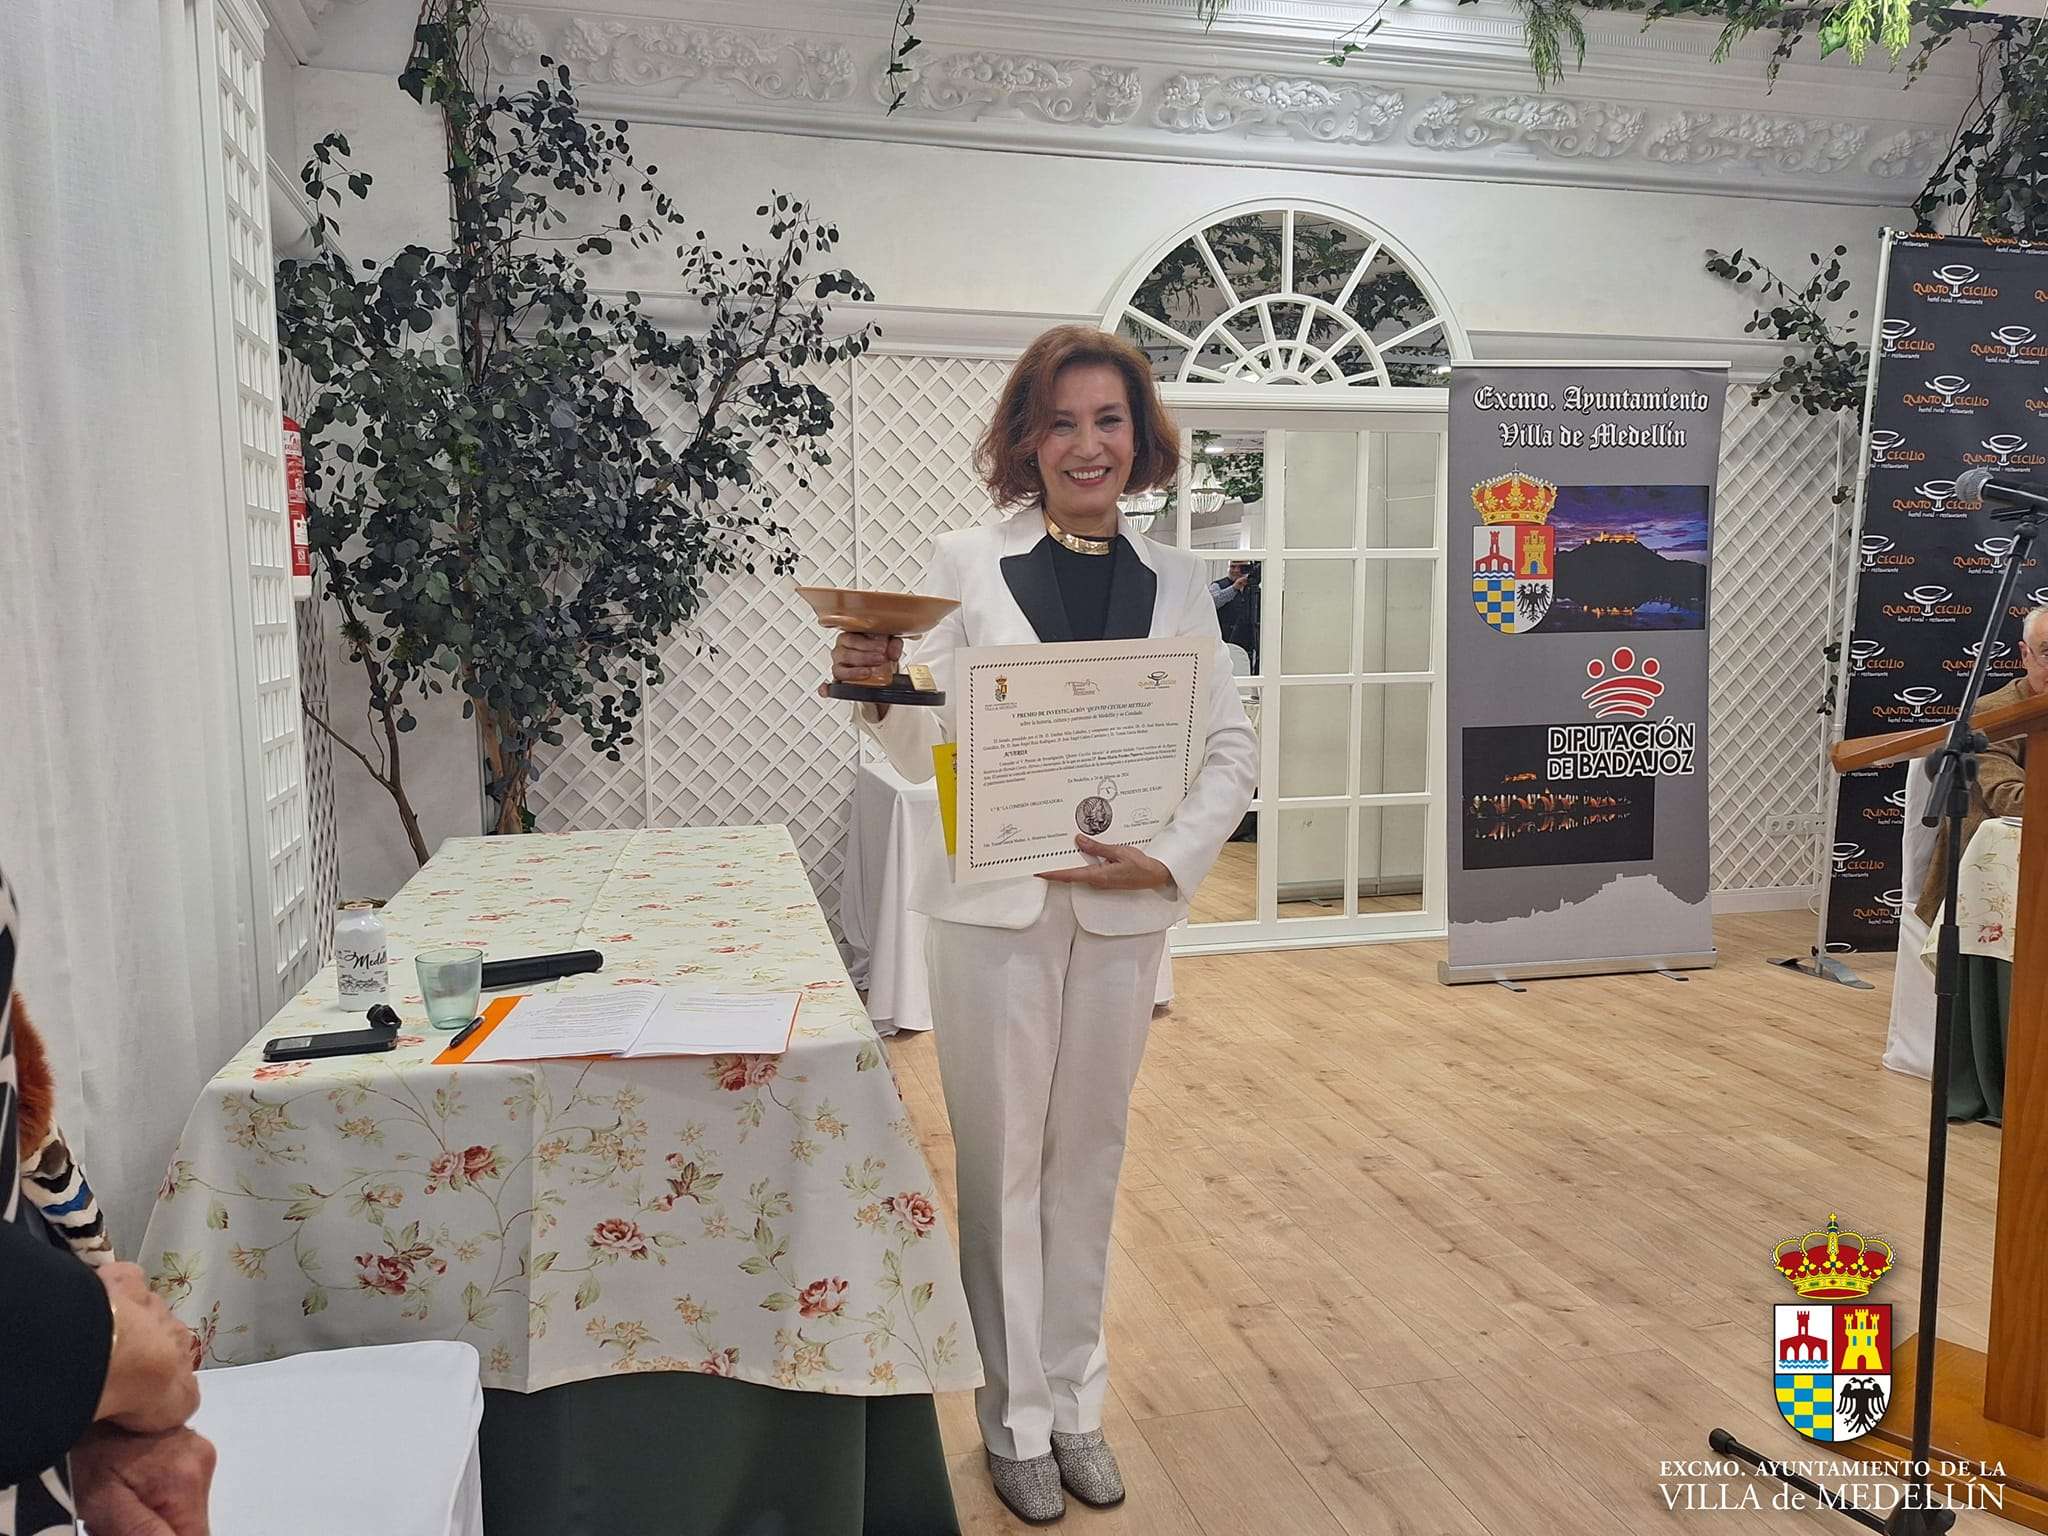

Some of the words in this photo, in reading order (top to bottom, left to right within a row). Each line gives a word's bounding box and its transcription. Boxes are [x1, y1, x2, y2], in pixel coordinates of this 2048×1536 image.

[1913, 283, 1949, 296] QUINTO
[1962, 286, 1998, 297] CECILIO
[1898, 340, 1935, 351] CECILIO
[1971, 343, 2006, 356] QUINTO
[2019, 346, 2048, 357] CECILI
[1474, 386, 1555, 411] Excmo.
[1563, 385, 1709, 414] Ayuntamiento
[1903, 394, 1942, 406] QUINTO
[1954, 396, 1989, 407] CECILIO
[1499, 422, 1554, 448] Villa
[1560, 424, 1583, 447] de
[1589, 422, 1687, 449] Medellín
[1887, 450, 1925, 461] CECILIO
[1962, 453, 1997, 465] QUINTO
[2010, 454, 2046, 465] CECILIO
[1892, 499, 1931, 512] QUINTO
[1877, 554, 1915, 565] CECILIO
[1953, 556, 1991, 568] QUINTO
[1882, 605, 1921, 617] QUINTO
[1935, 604, 1972, 615] CECILIO
[1867, 658, 1904, 669] CECILIO
[1942, 660, 1976, 672] QUINT
[1872, 706, 1911, 718] QUINTO
[1549, 717, 1695, 754] DIPUTACIÓN
[1548, 758, 1573, 780] DE
[1578, 750, 1694, 778] BADAJOZ
[1862, 808, 1900, 820] QUINTO
[1847, 861, 1885, 870] CECILIO
[1853, 908, 1890, 920] QUINTO
